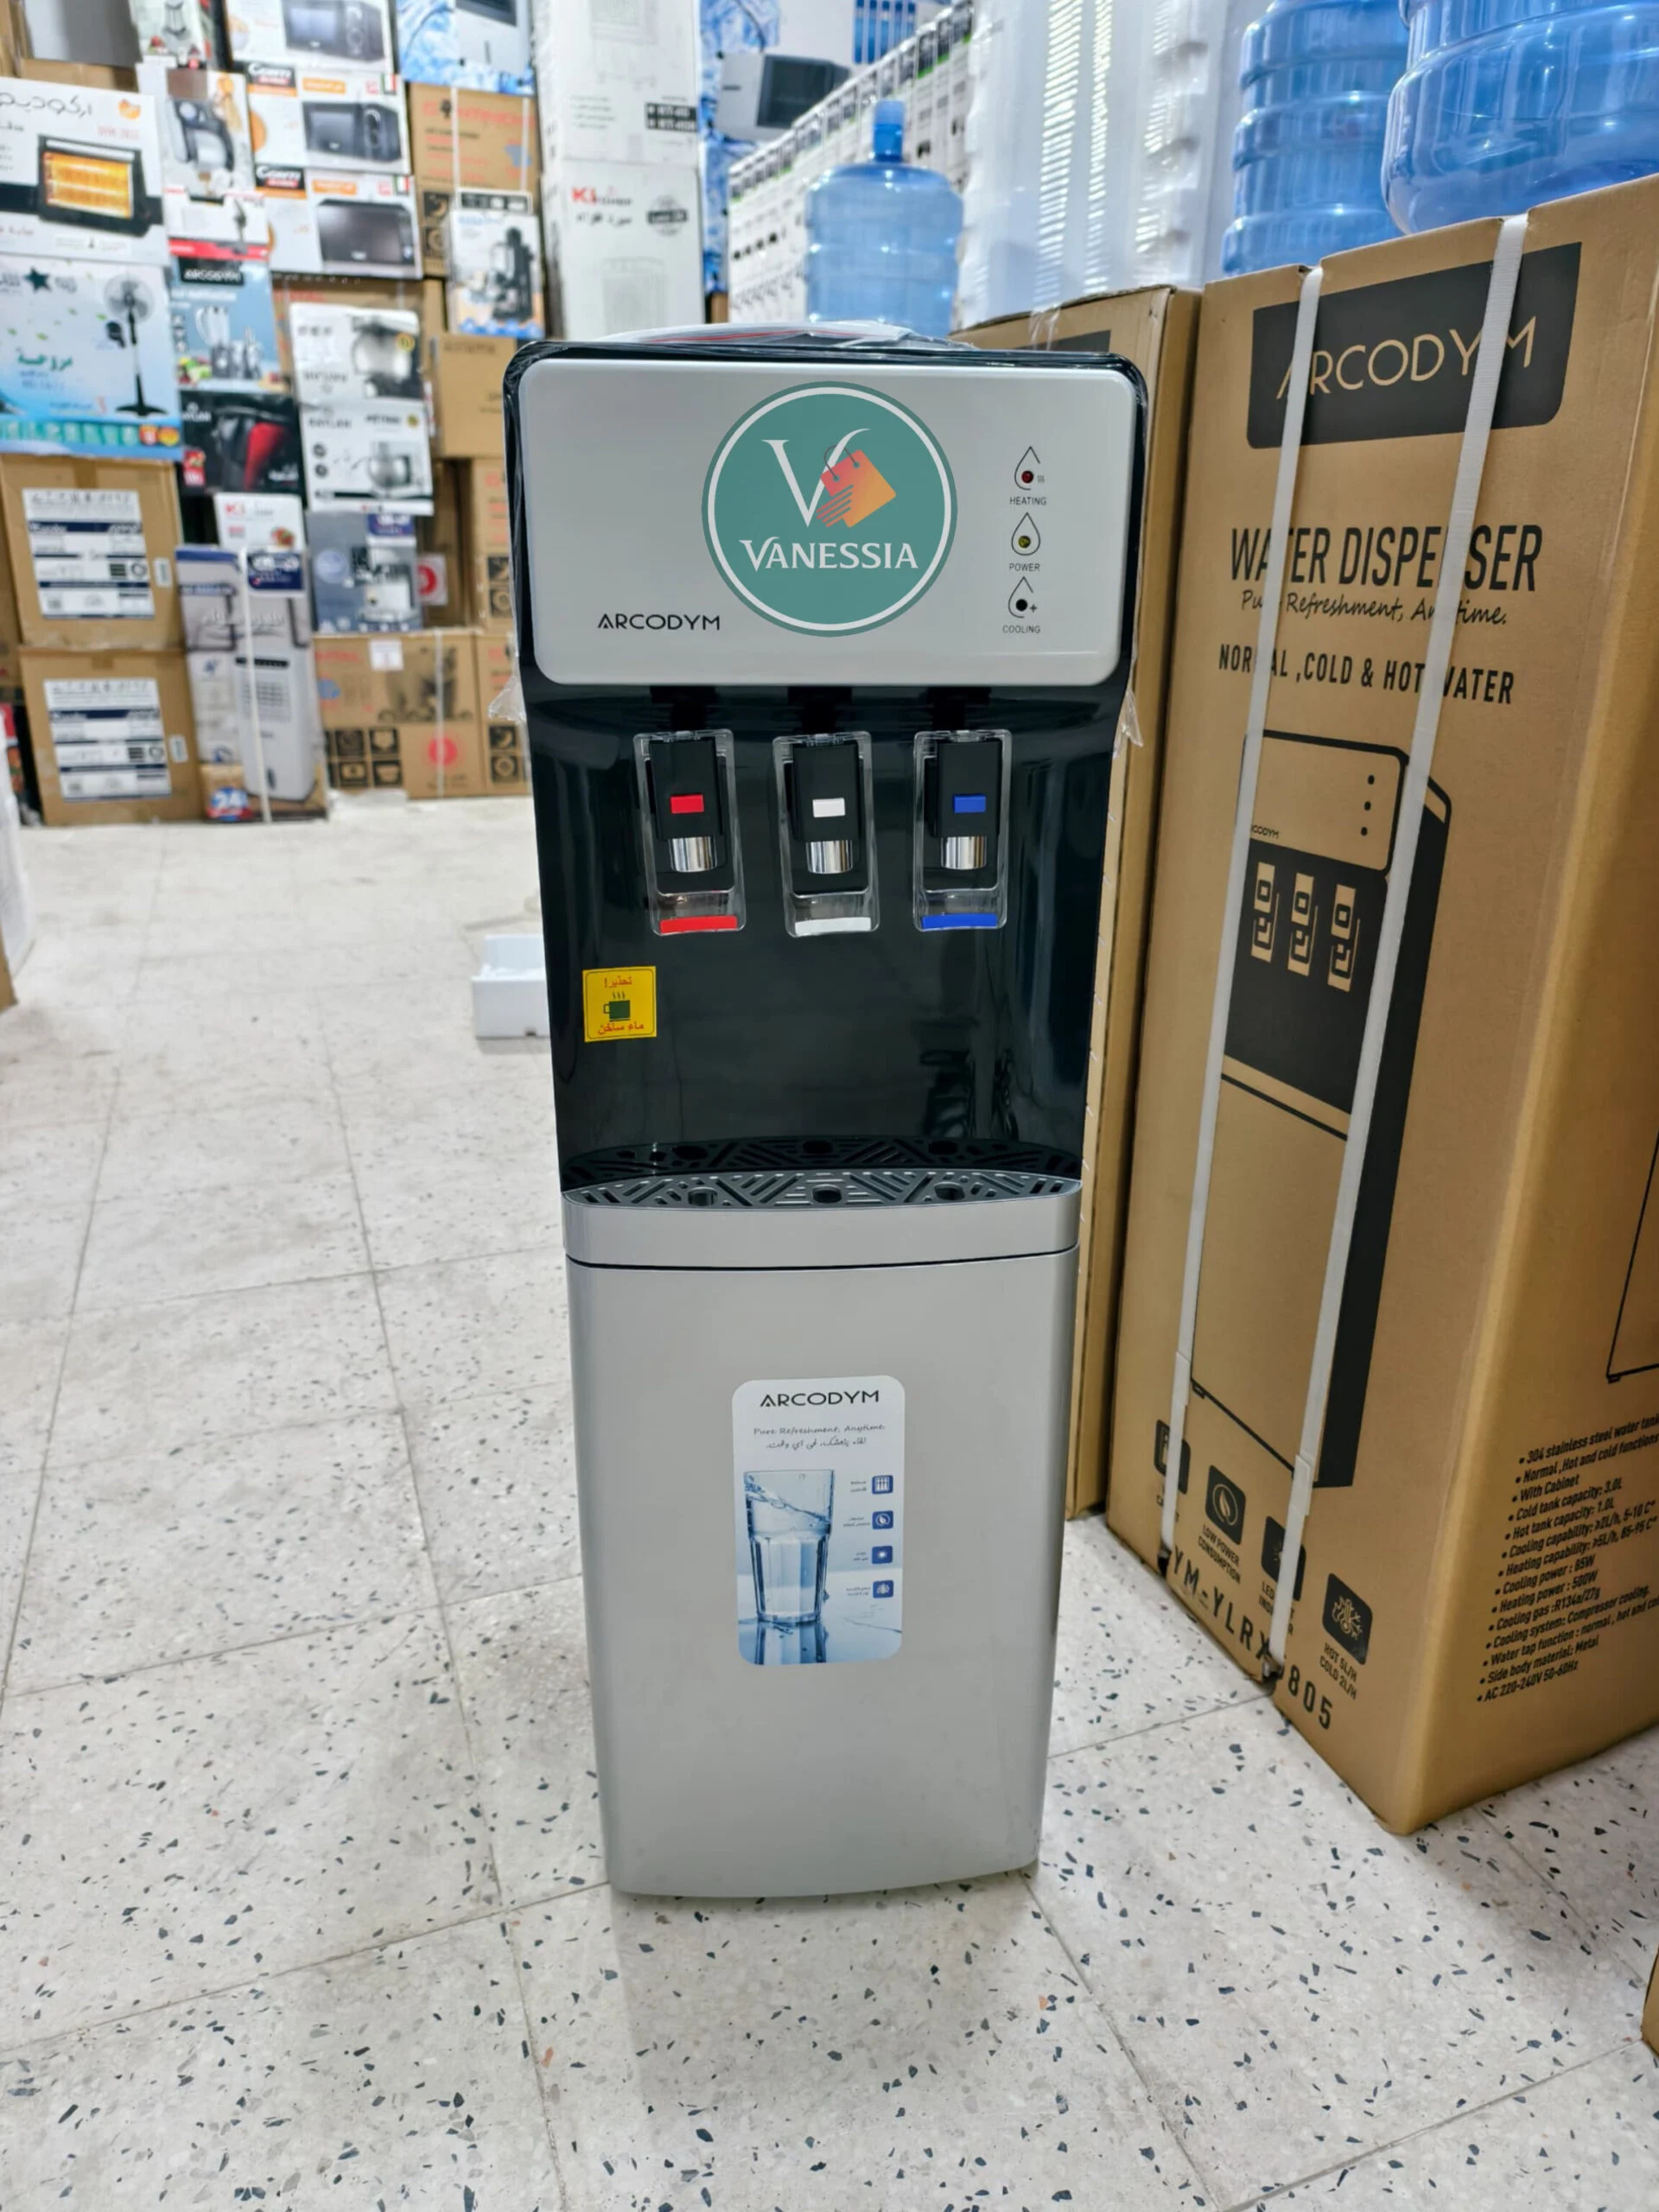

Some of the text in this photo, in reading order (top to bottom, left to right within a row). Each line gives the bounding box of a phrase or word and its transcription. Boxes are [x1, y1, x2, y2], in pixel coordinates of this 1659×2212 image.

[1009, 496, 1047, 505] HEATING
[1009, 563, 1040, 572] POWER
[1230, 524, 1543, 592] WAER DISPESER
[1286, 591, 1403, 623] Refreshment,
[597, 613, 721, 632] ARCODYM
[1002, 625, 1041, 634] COOLING
[1219, 644, 1288, 677] NORAL
[1361, 658, 1374, 688] &
[1383, 659, 1426, 694] HOT
[597, 1021, 645, 1035] ماء ساخن
[760, 1389, 880, 1408] ARCODYM
[1527, 1448, 1544, 1464] 304
[1546, 1438, 1588, 1458] stainless
[1589, 1427, 1611, 1445] steel
[1523, 1462, 1558, 1482] Normal
[1580, 1452, 1597, 1466] and
[1598, 1444, 1618, 1460] cold
[1521, 1475, 1580, 1501] With Cabinet
[1516, 1503, 1538, 1521] Cold
[1539, 1497, 1560, 1514] tank
[1513, 1525, 1529, 1539] Hot
[1531, 1518, 1552, 1534] tank
[1202, 1523, 1240, 1567] LOW POWER
[1510, 1539, 1545, 1558] Cooling
[1506, 1557, 1541, 1575] Heating
[1503, 1575, 1538, 1594] Cooling
[1539, 1566, 1567, 1585] power
[1500, 1593, 1535, 1611] Heating
[1536, 1584, 1566, 1603] power
[1497, 1611, 1531, 1630] Cooling
[1533, 1605, 1549, 1622] gas
[1491, 1649, 1519, 1665] Water
[1522, 1643, 1536, 1656] tap
[1538, 1630, 1574, 1649] function
[1493, 1630, 1529, 1648] Cooling
[1325, 1642, 1338, 1663] HOT
[1488, 1669, 1509, 1683] Side
[1510, 1662, 1532, 1676] body
[1575, 1637, 1599, 1652] Metal
[1319, 1655, 1339, 1681] COLD
[1484, 1687, 1499, 1701] AC
